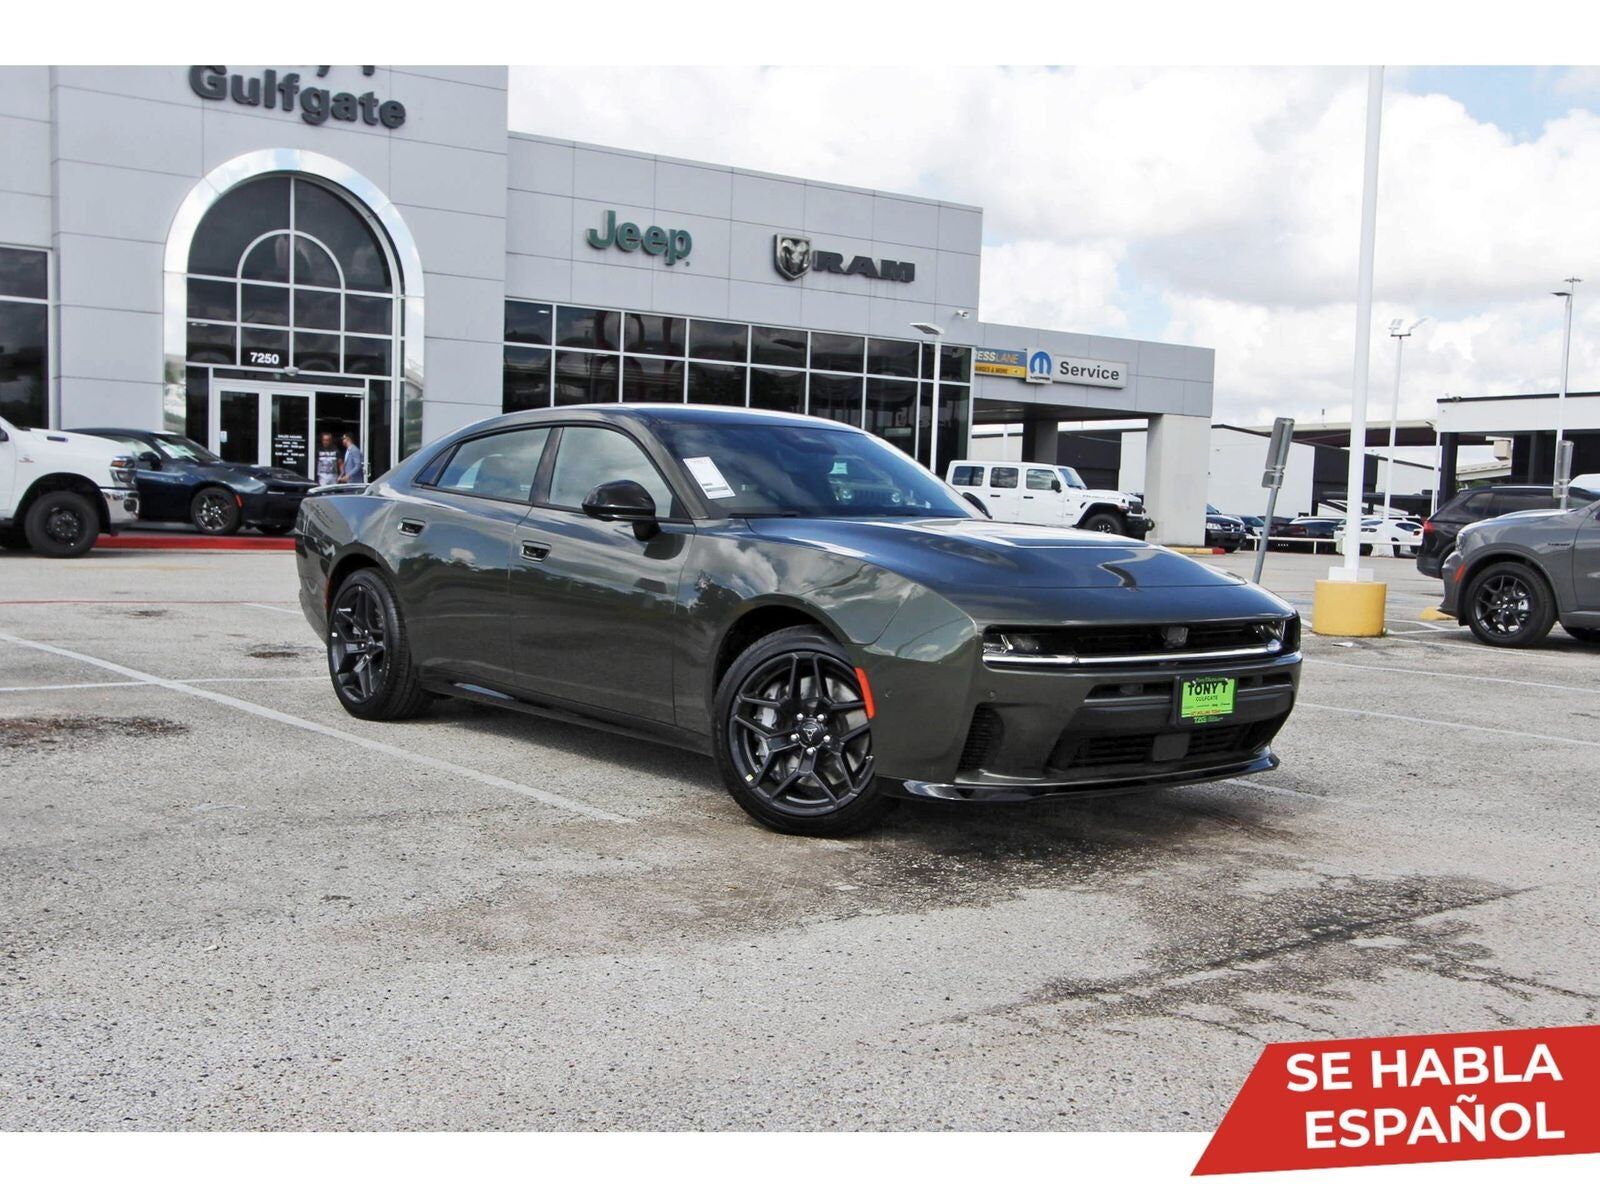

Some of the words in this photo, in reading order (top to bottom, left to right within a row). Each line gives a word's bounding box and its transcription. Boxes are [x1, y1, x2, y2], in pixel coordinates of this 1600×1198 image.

[188, 65, 406, 129] Gulfgate
[586, 210, 692, 266] Jeep
[812, 250, 916, 283] RAM
[250, 352, 279, 364] 7250
[1060, 361, 1120, 380] Service
[1188, 680, 1219, 696] TONY
